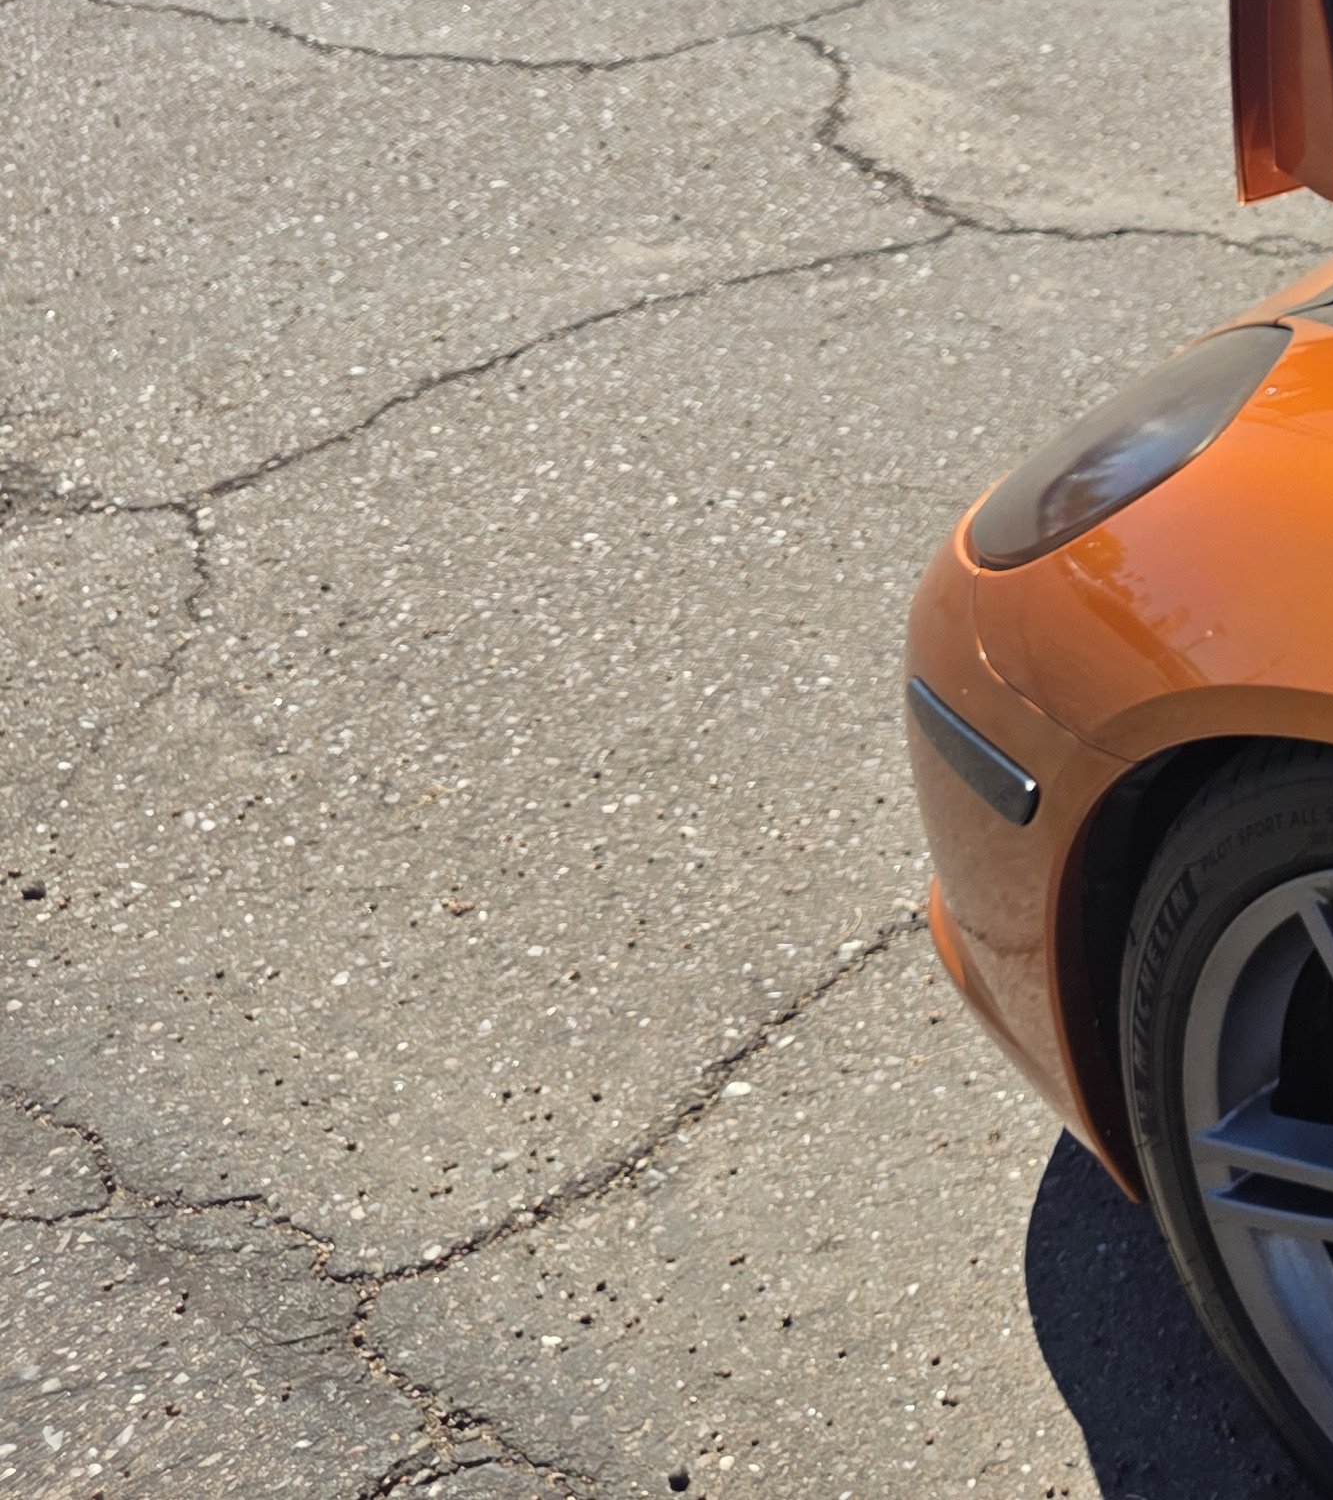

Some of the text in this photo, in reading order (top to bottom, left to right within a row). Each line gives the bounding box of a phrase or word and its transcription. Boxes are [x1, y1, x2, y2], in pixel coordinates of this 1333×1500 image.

[1199, 833, 1234, 873] PILOT
[1238, 811, 1285, 847] SPORT
[1287, 806, 1319, 829] ALL
[1132, 876, 1196, 1080] MICHELIN
